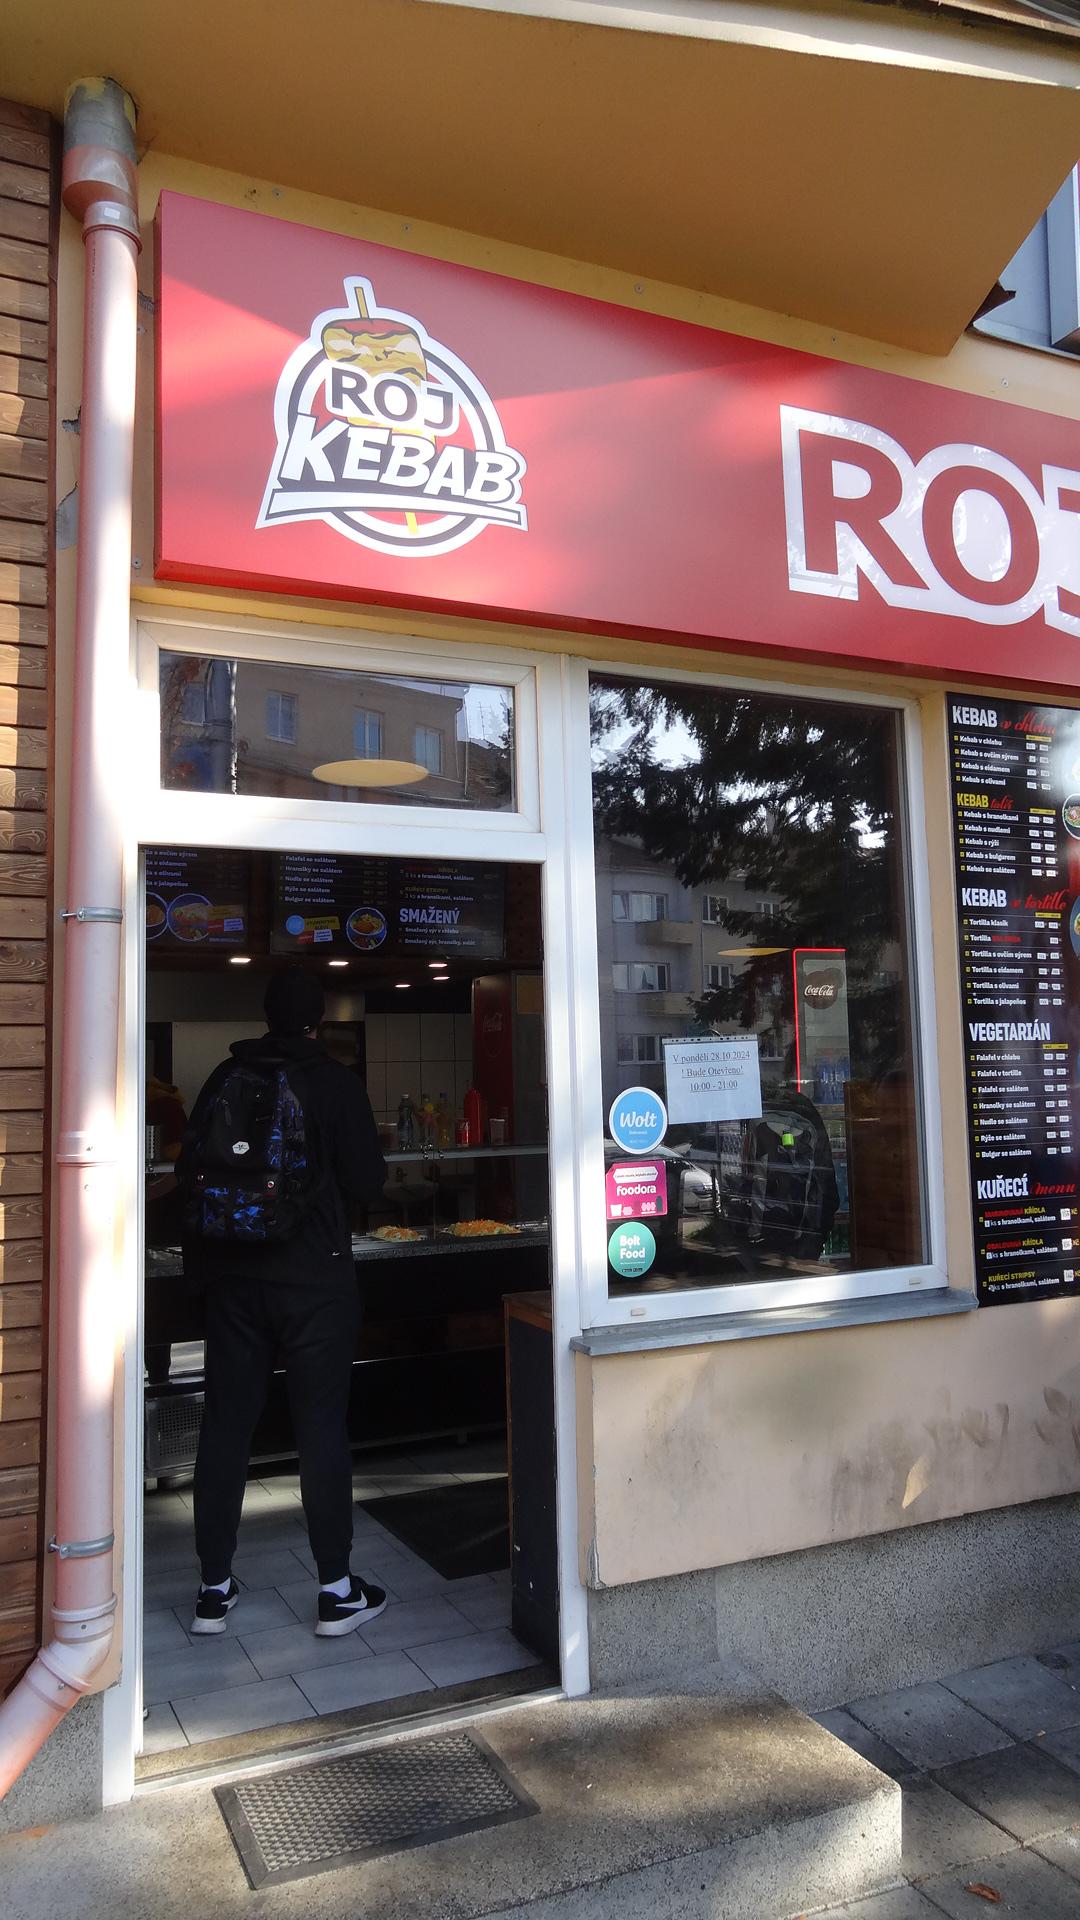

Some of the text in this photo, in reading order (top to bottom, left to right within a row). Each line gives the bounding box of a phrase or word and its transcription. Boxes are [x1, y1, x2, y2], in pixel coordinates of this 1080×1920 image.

[331, 366, 453, 430] ROJ
[280, 412, 517, 503] KEBAB
[790, 418, 1080, 628] RO
[953, 706, 997, 728] KEBAB
[960, 735, 977, 743] Kebab
[983, 738, 1002, 746] chlebu
[957, 793, 988, 807] KEBAB
[987, 813, 1018, 821] hranolkami
[962, 888, 1006, 907] KEBAB
[400, 906, 460, 924] SMAŽENÝ
[969, 1019, 1051, 1041] VEGETARIÁN
[682, 1052, 709, 1064] pondělí
[687, 1069, 705, 1077] Bude
[620, 1111, 657, 1127] Wolt
[617, 1184, 656, 1196] foodora
[977, 1173, 1028, 1199] KUŘECÍ
[620, 1235, 640, 1247] Bolt
[621, 1248, 645, 1259] Food
[989, 1273, 1010, 1282] KUŘECÍ
[1011, 1271, 1035, 1279] STRIPSY
